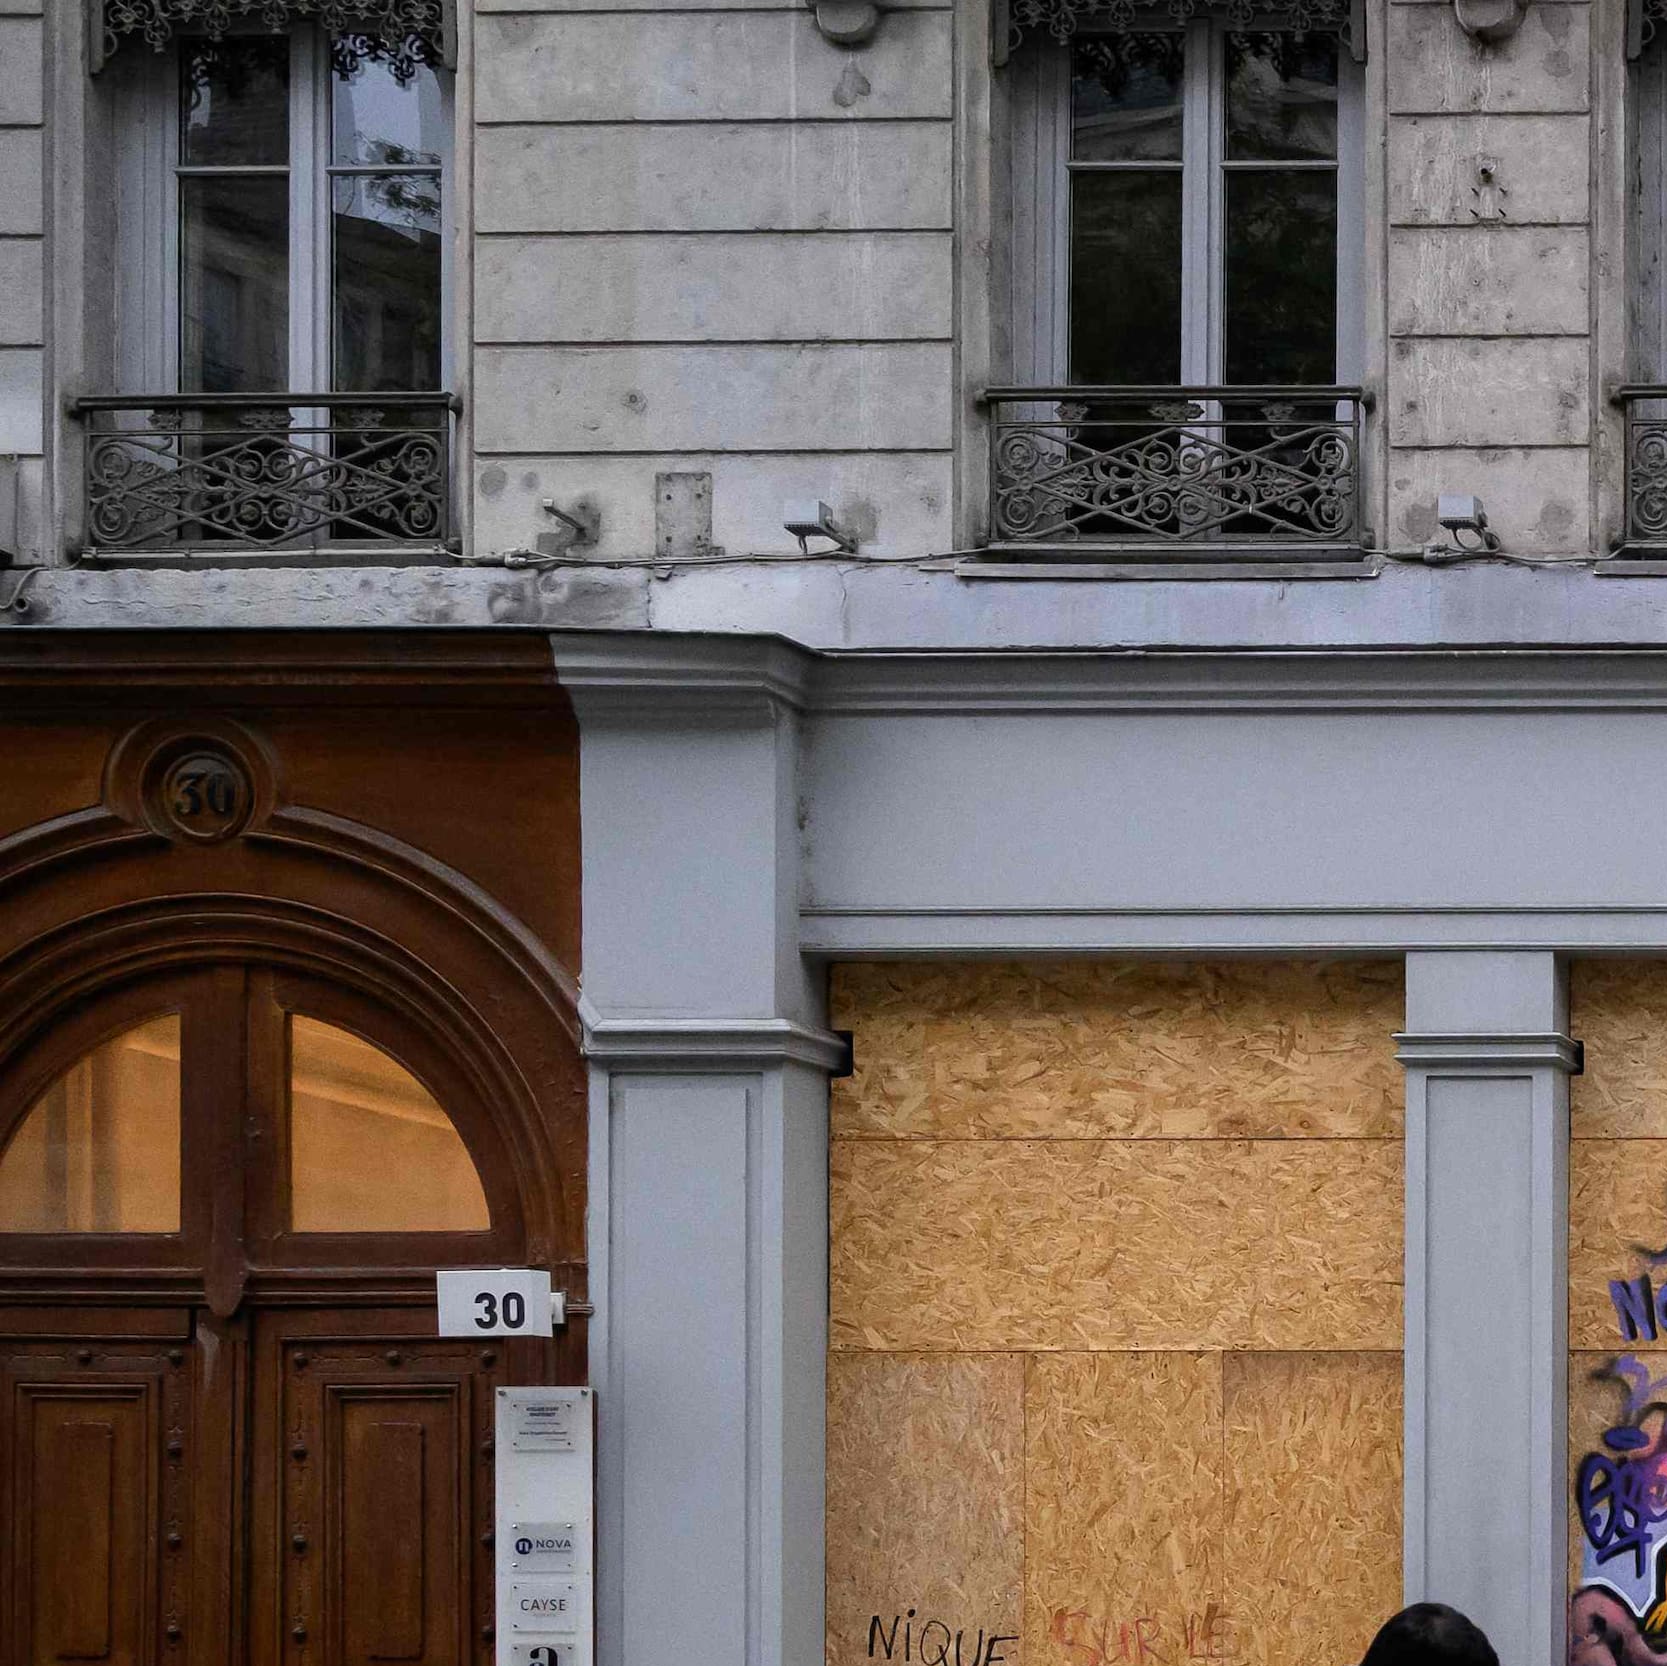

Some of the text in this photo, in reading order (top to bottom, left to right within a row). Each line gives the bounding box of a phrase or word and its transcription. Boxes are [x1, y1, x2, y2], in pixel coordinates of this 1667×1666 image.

[174, 771, 236, 817] 30
[475, 1293, 525, 1329] 30
[535, 1539, 572, 1549] NOVA
[520, 1599, 567, 1611] CAYSE
